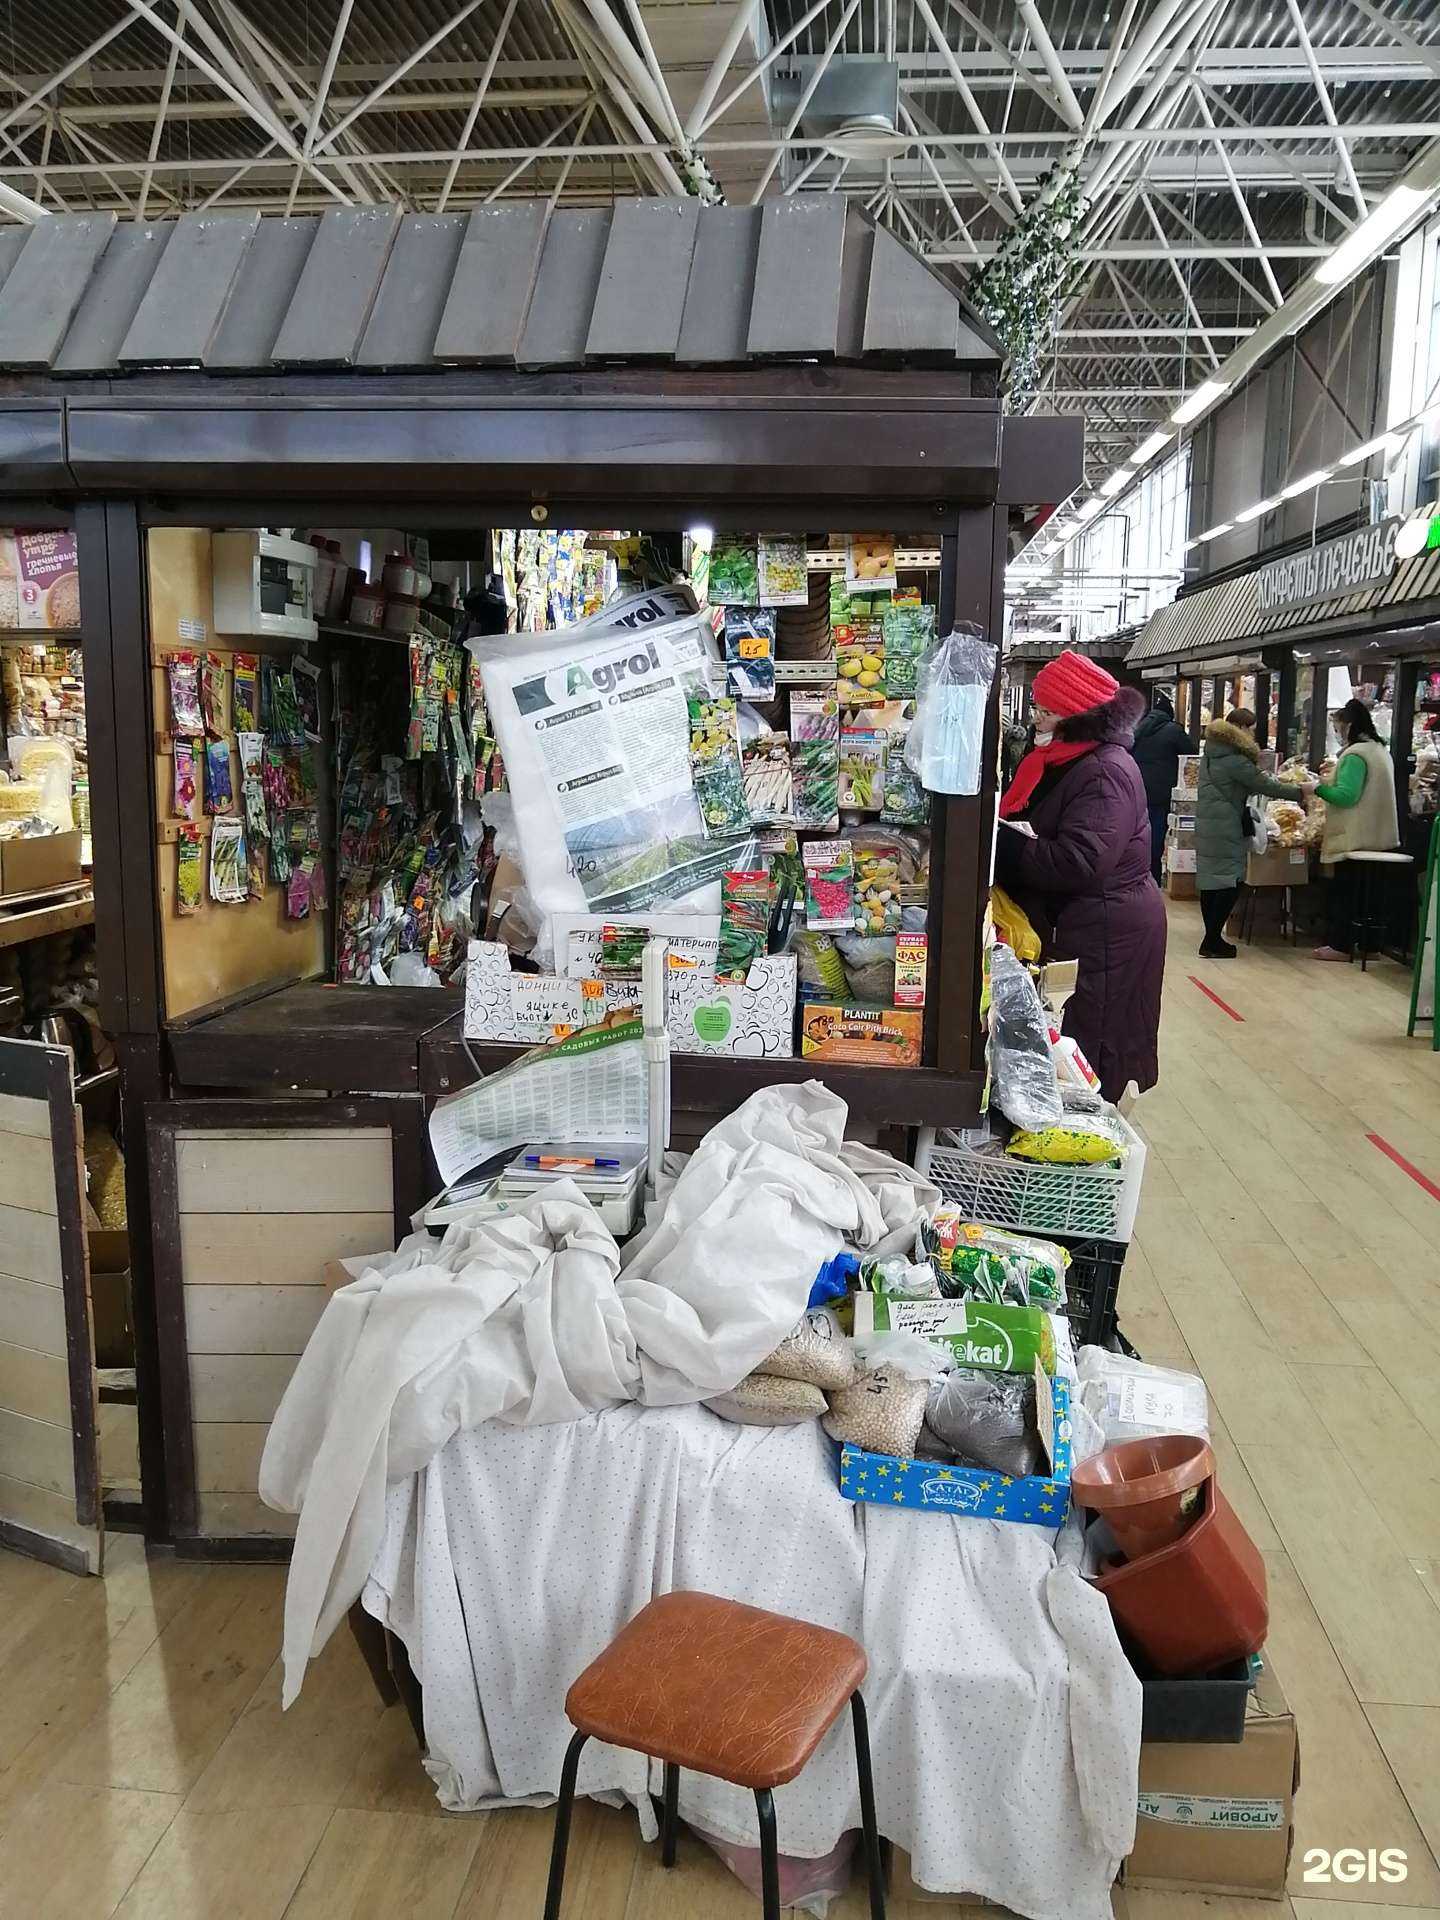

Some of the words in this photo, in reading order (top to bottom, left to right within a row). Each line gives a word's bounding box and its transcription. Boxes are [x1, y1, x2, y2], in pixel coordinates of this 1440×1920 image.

[26, 589, 34, 600] 3
[566, 642, 661, 694] Agrol
[897, 951, 926, 962] ФАС
[844, 1010, 880, 1020] PLANTIT
[883, 1026, 904, 1036] Brick
[1210, 1811, 1279, 1823] АГРОВИТ
